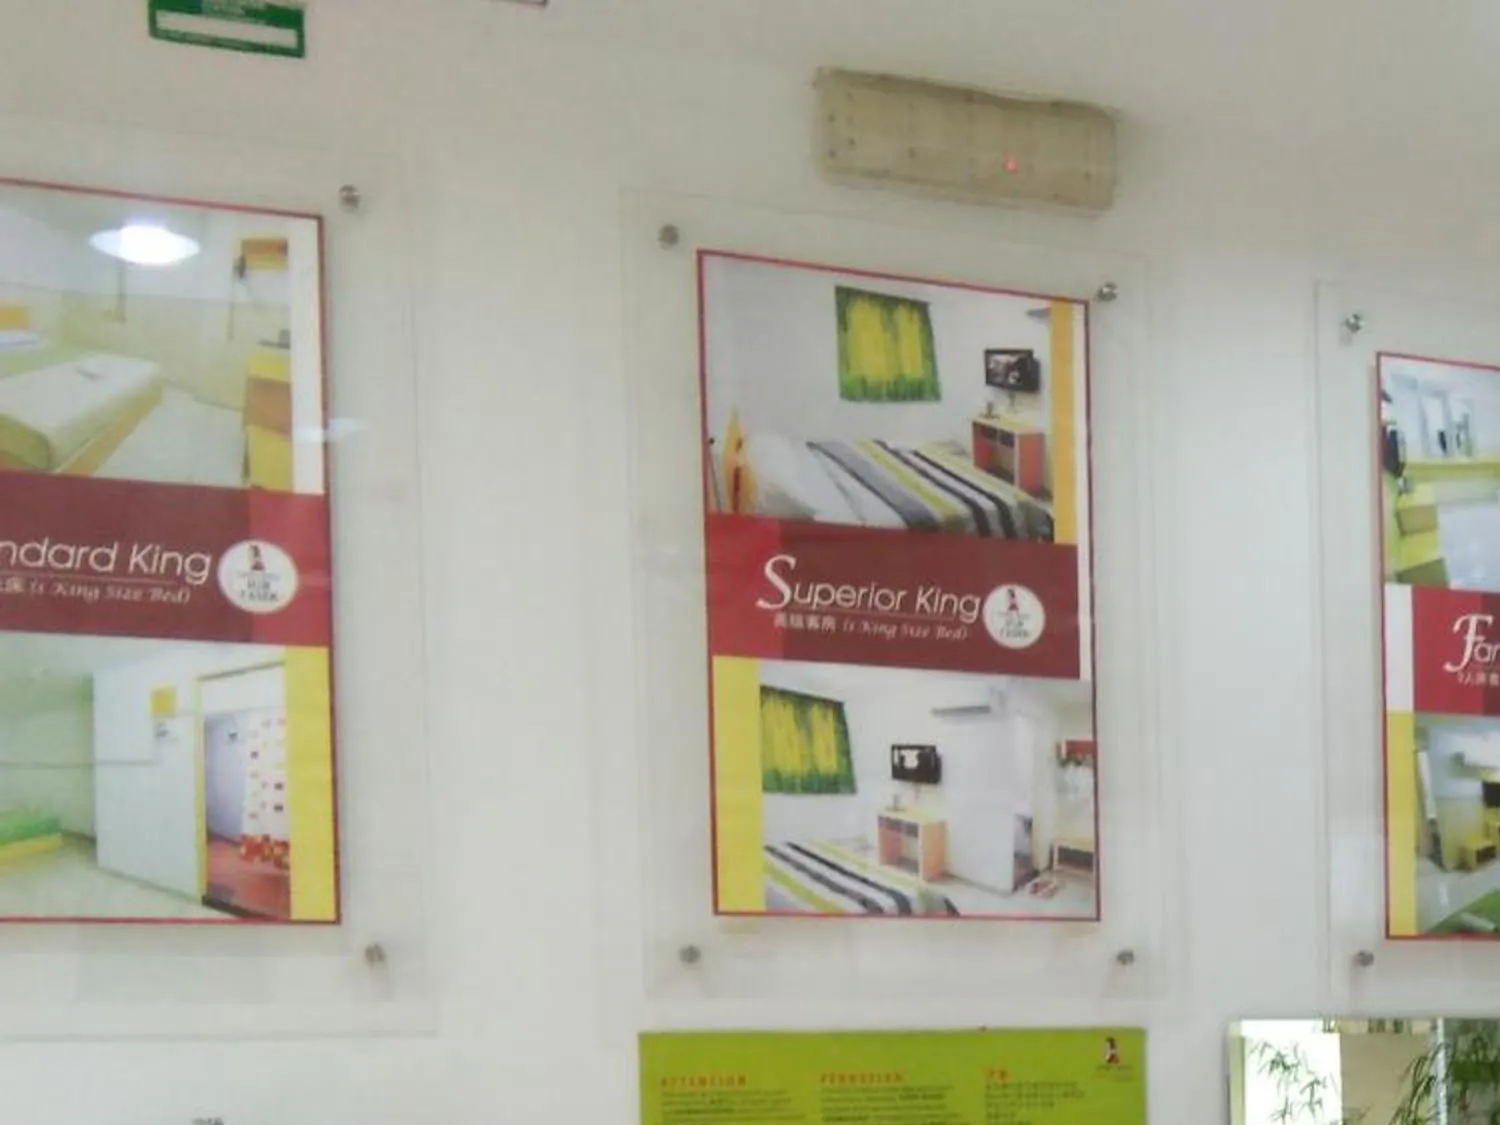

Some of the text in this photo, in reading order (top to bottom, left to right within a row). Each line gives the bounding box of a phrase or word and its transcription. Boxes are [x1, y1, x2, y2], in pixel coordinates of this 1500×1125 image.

[128, 543, 212, 585] King
[755, 554, 982, 624] Superior King
